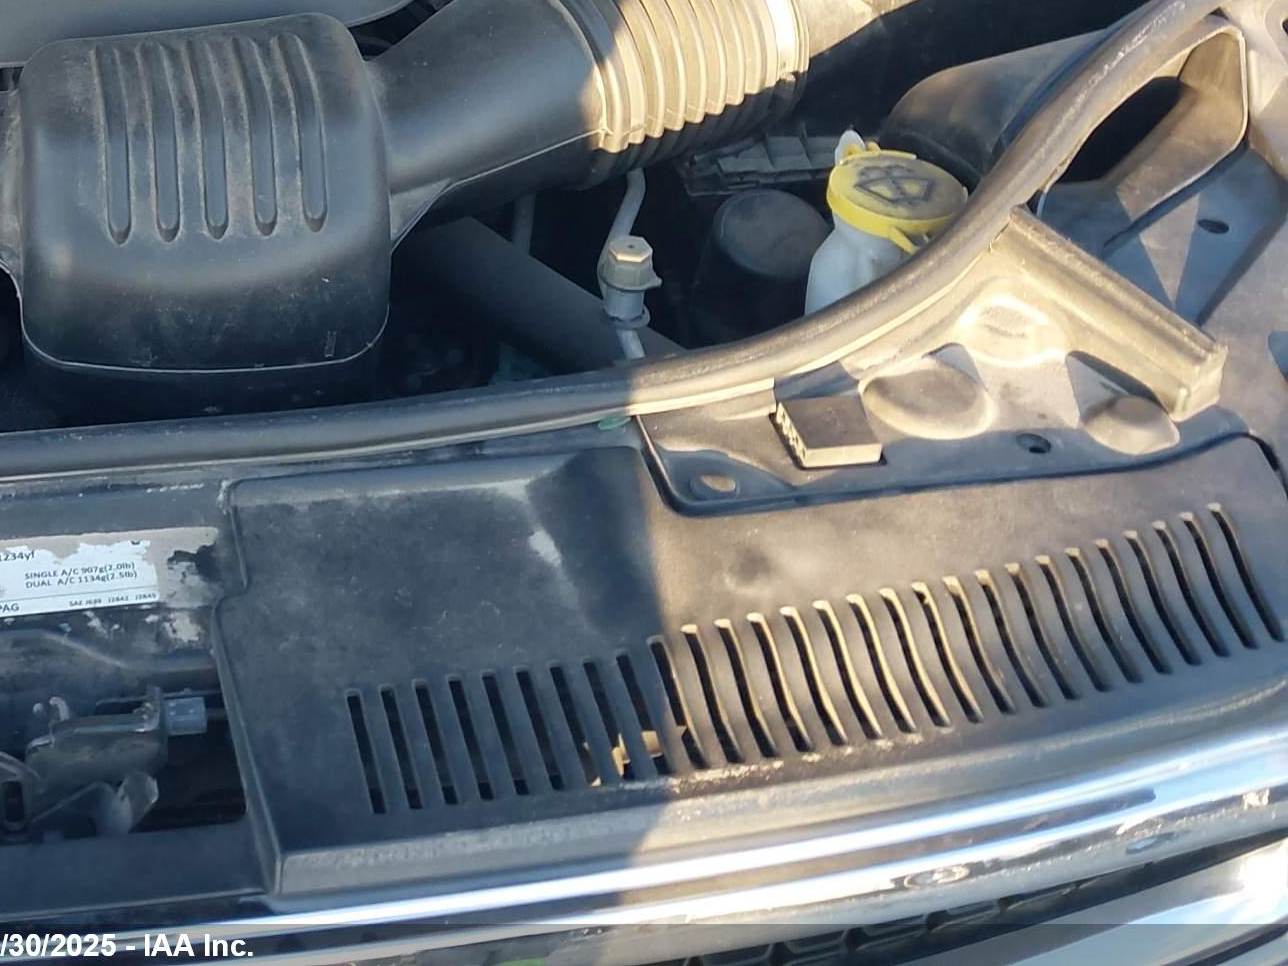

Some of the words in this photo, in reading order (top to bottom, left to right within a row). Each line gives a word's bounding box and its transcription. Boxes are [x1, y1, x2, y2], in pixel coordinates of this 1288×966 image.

[24, 569, 59, 580] SINGLE
[61, 567, 80, 578] A/C
[81, 561, 136, 576] 907g(2.0lb)
[25, 580, 52, 589] DUAL
[57, 576, 76, 587] A/C
[78, 570, 139, 584] 1134g(2.5lb)
